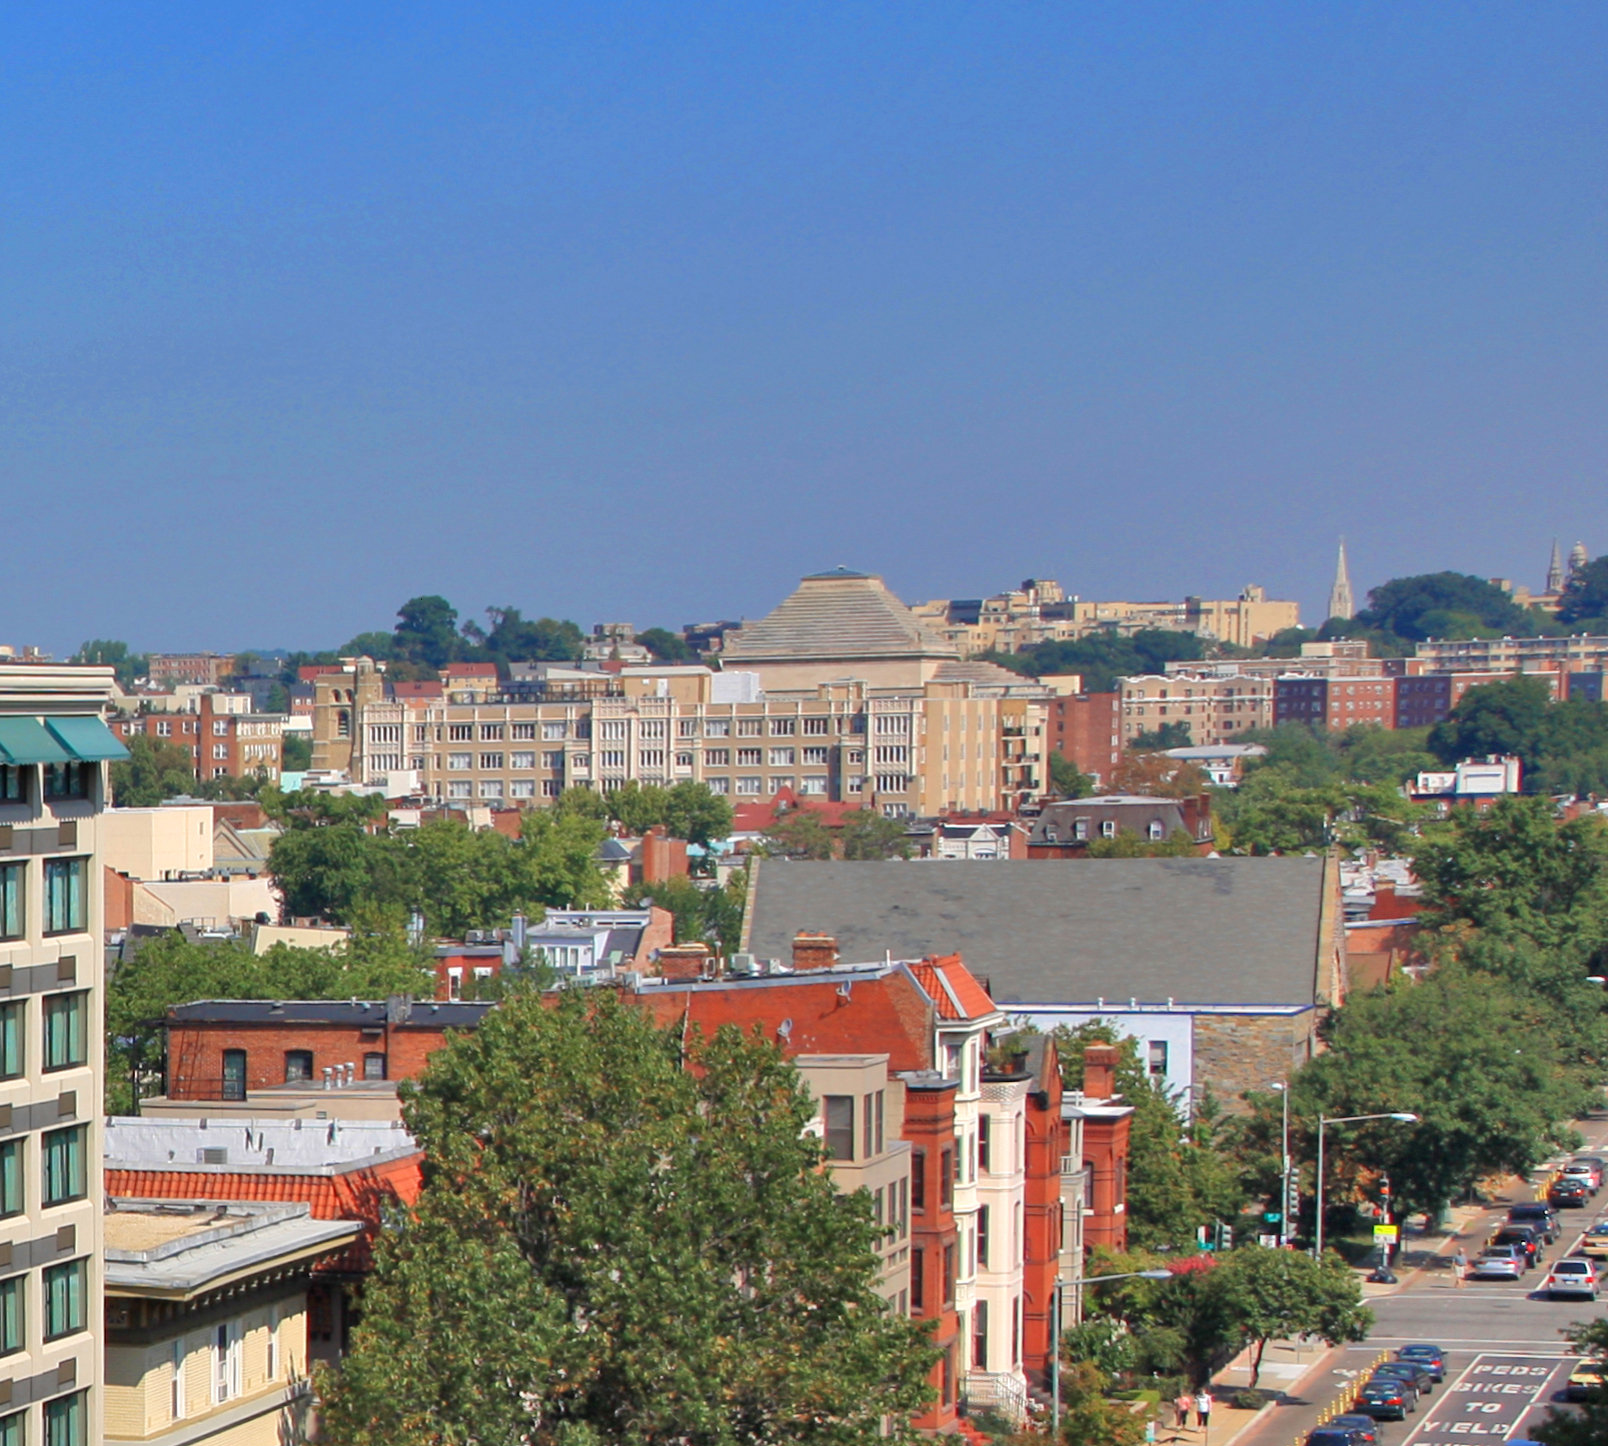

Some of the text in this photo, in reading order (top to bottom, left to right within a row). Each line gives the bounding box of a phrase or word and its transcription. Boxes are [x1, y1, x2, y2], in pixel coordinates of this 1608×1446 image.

[1472, 1364, 1548, 1376] PEDS
[1452, 1382, 1541, 1395] BIKES
[1465, 1401, 1502, 1413] TO
[1423, 1421, 1510, 1435] YIELD
